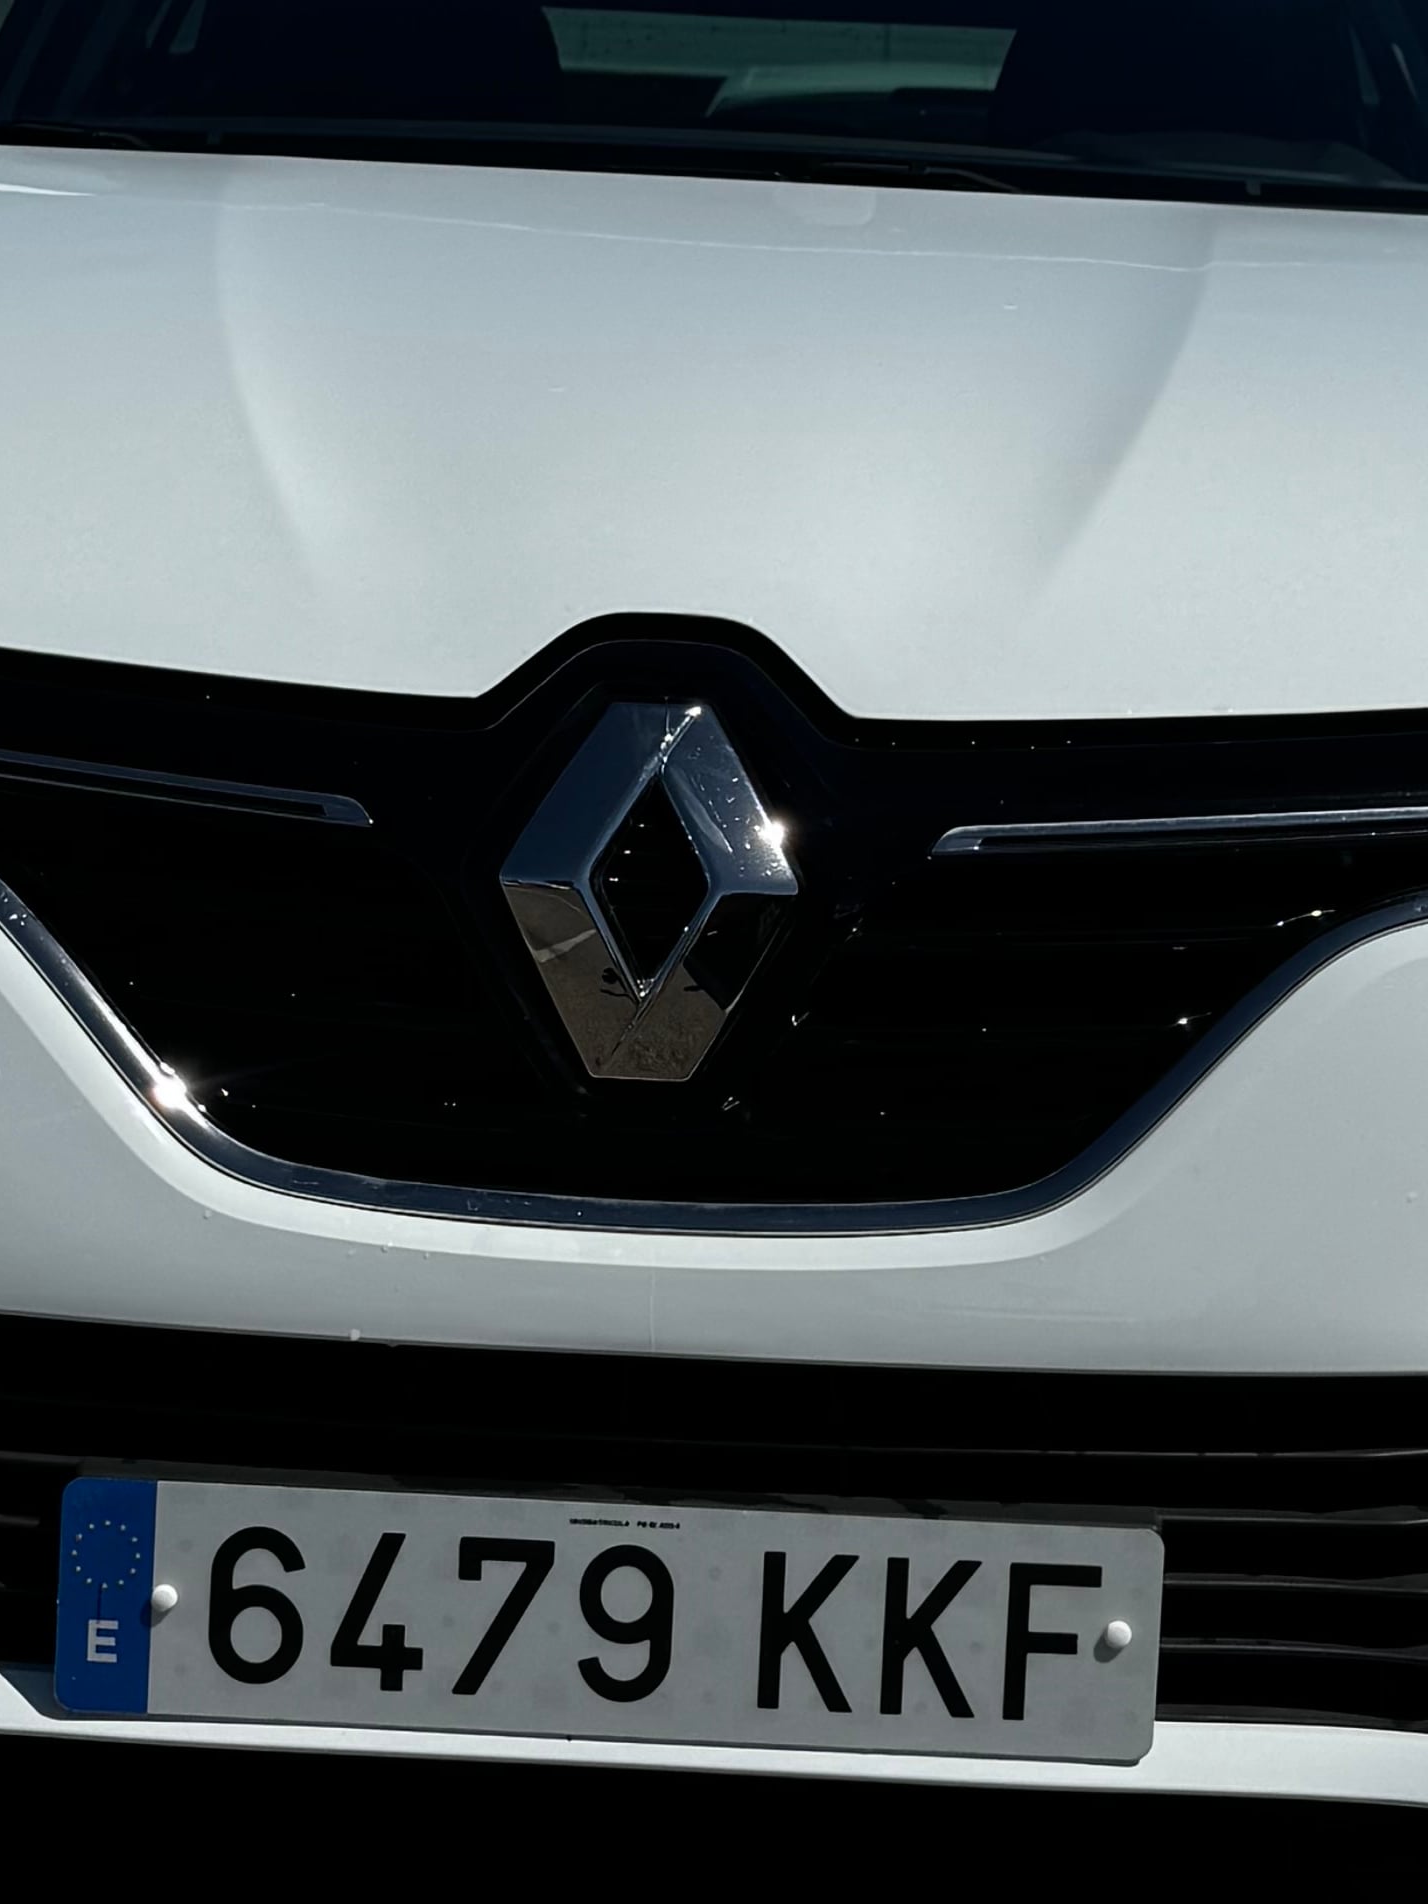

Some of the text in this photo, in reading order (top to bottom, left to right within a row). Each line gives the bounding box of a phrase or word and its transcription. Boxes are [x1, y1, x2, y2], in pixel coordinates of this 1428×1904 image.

[86, 1619, 119, 1664] E
[207, 1525, 1104, 1722] 6479 KKF
